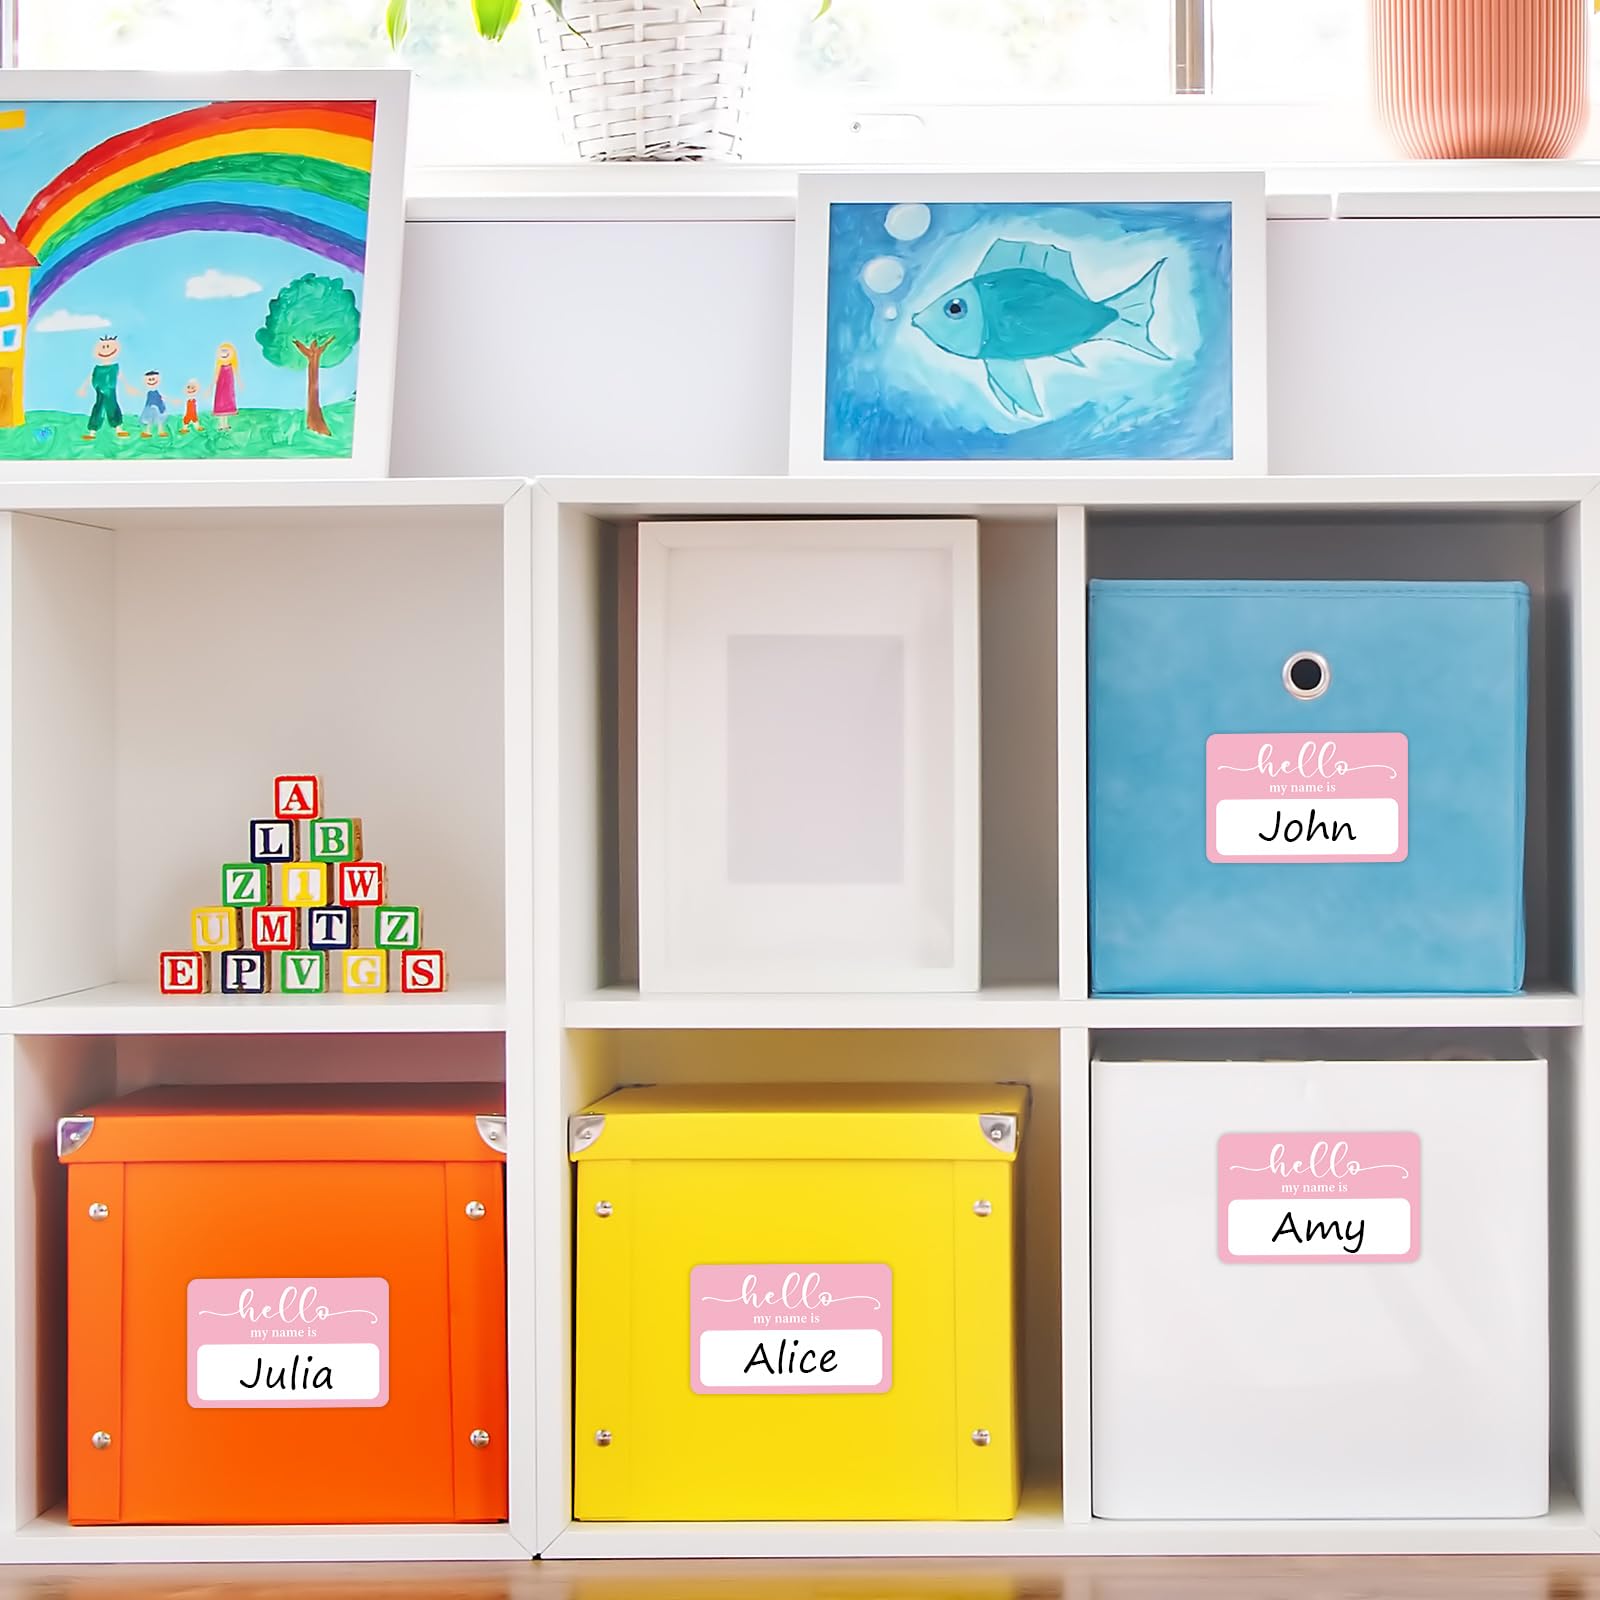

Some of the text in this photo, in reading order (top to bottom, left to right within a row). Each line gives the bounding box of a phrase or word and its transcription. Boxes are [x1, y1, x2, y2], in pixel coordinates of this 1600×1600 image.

[281, 783, 311, 811] A
[1269, 781, 1336, 796] my name is
[320, 826, 344, 853] B
[1258, 809, 1357, 842] John
[259, 827, 283, 855] L
[231, 871, 255, 900] Z
[296, 871, 314, 900] 1
[346, 870, 376, 897] W
[197, 915, 224, 944] U
[260, 914, 288, 942] M
[316, 913, 343, 940] T
[387, 914, 411, 942] Z
[168, 959, 193, 986] E
[232, 958, 256, 986] P
[290, 958, 314, 985] V
[351, 959, 376, 986] G
[411, 959, 434, 986] S
[1281, 1181, 1348, 1196] my name is
[1272, 1212, 1365, 1254] Amy
[250, 1326, 317, 1341] my name is
[753, 1312, 820, 1327] my name is
[743, 1338, 838, 1375] Alice
[239, 1354, 333, 1390] Julia
